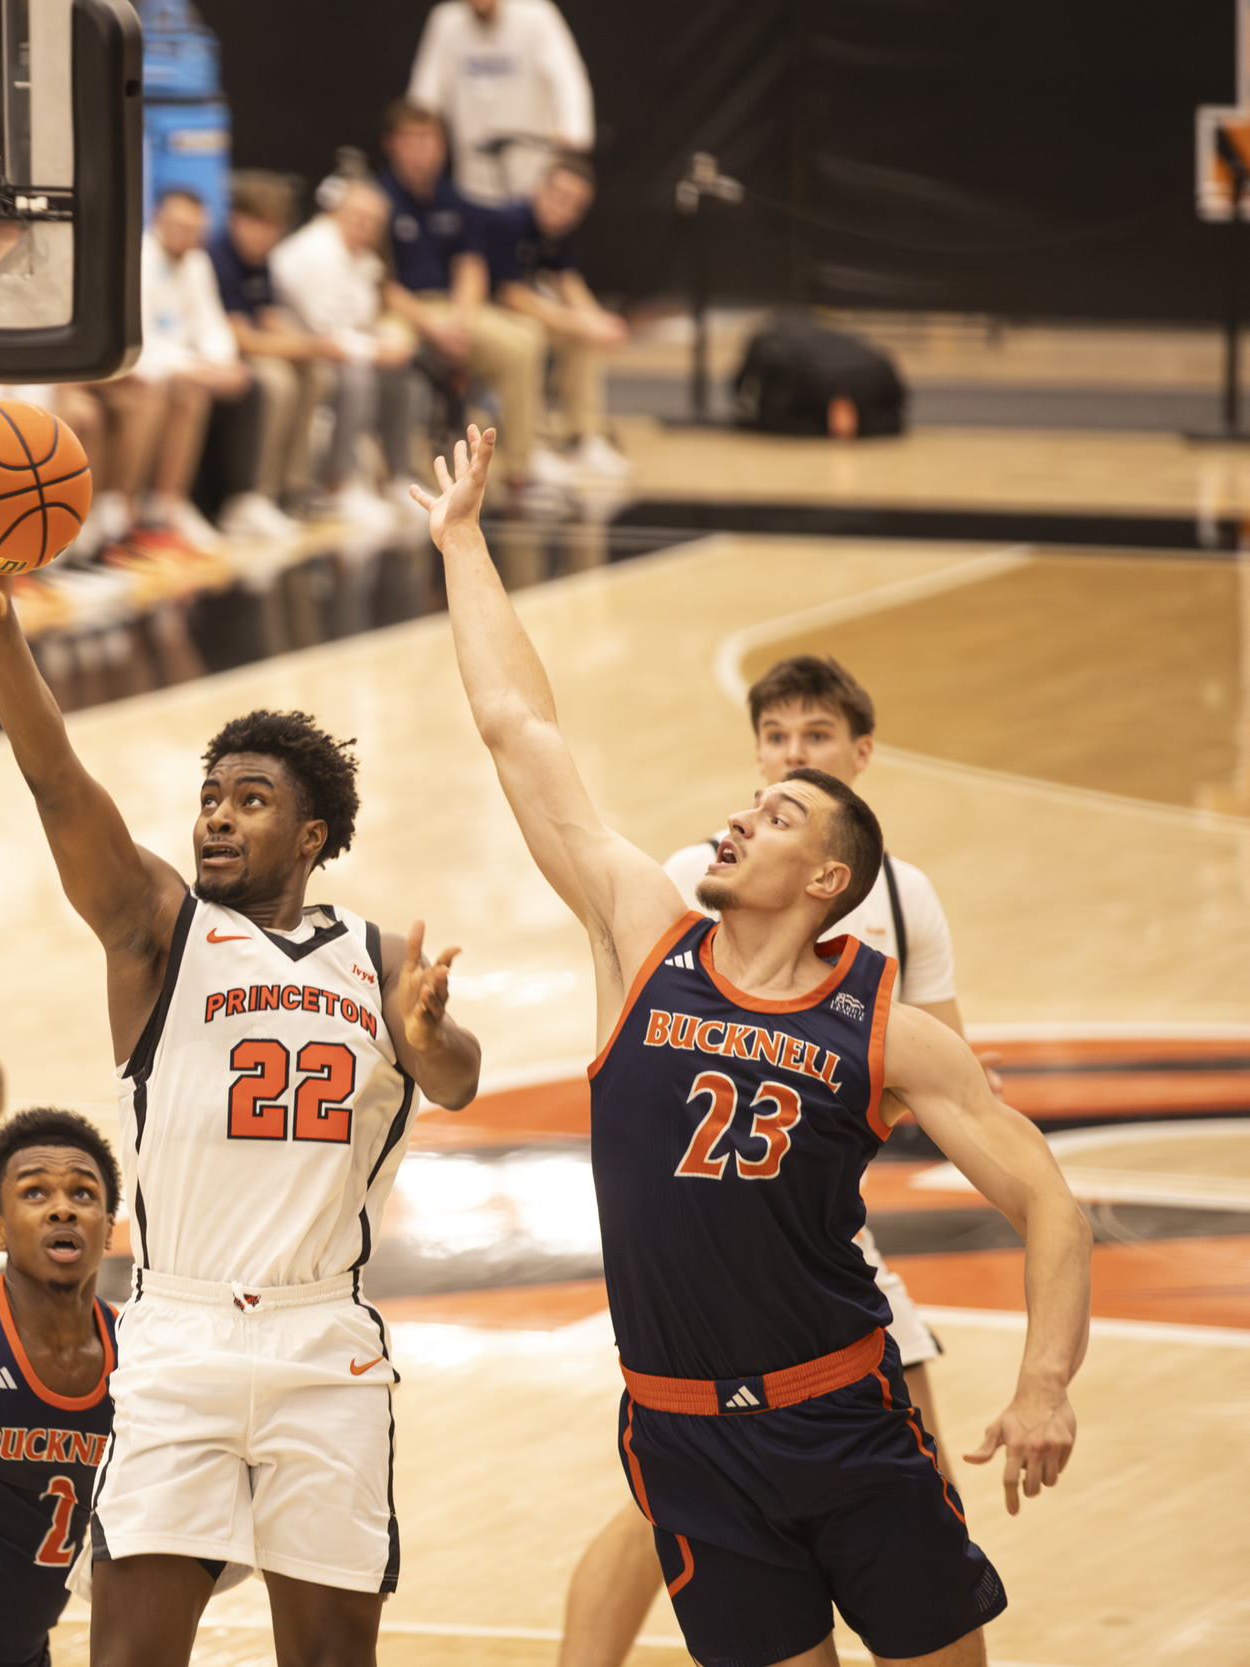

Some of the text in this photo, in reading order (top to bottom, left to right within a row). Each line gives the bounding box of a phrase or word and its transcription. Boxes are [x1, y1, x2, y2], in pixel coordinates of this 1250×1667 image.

[204, 984, 378, 1041] PRINCETON
[643, 1009, 843, 1094] BUCKNELL
[227, 1038, 357, 1145] 22
[674, 1070, 802, 1181] 23
